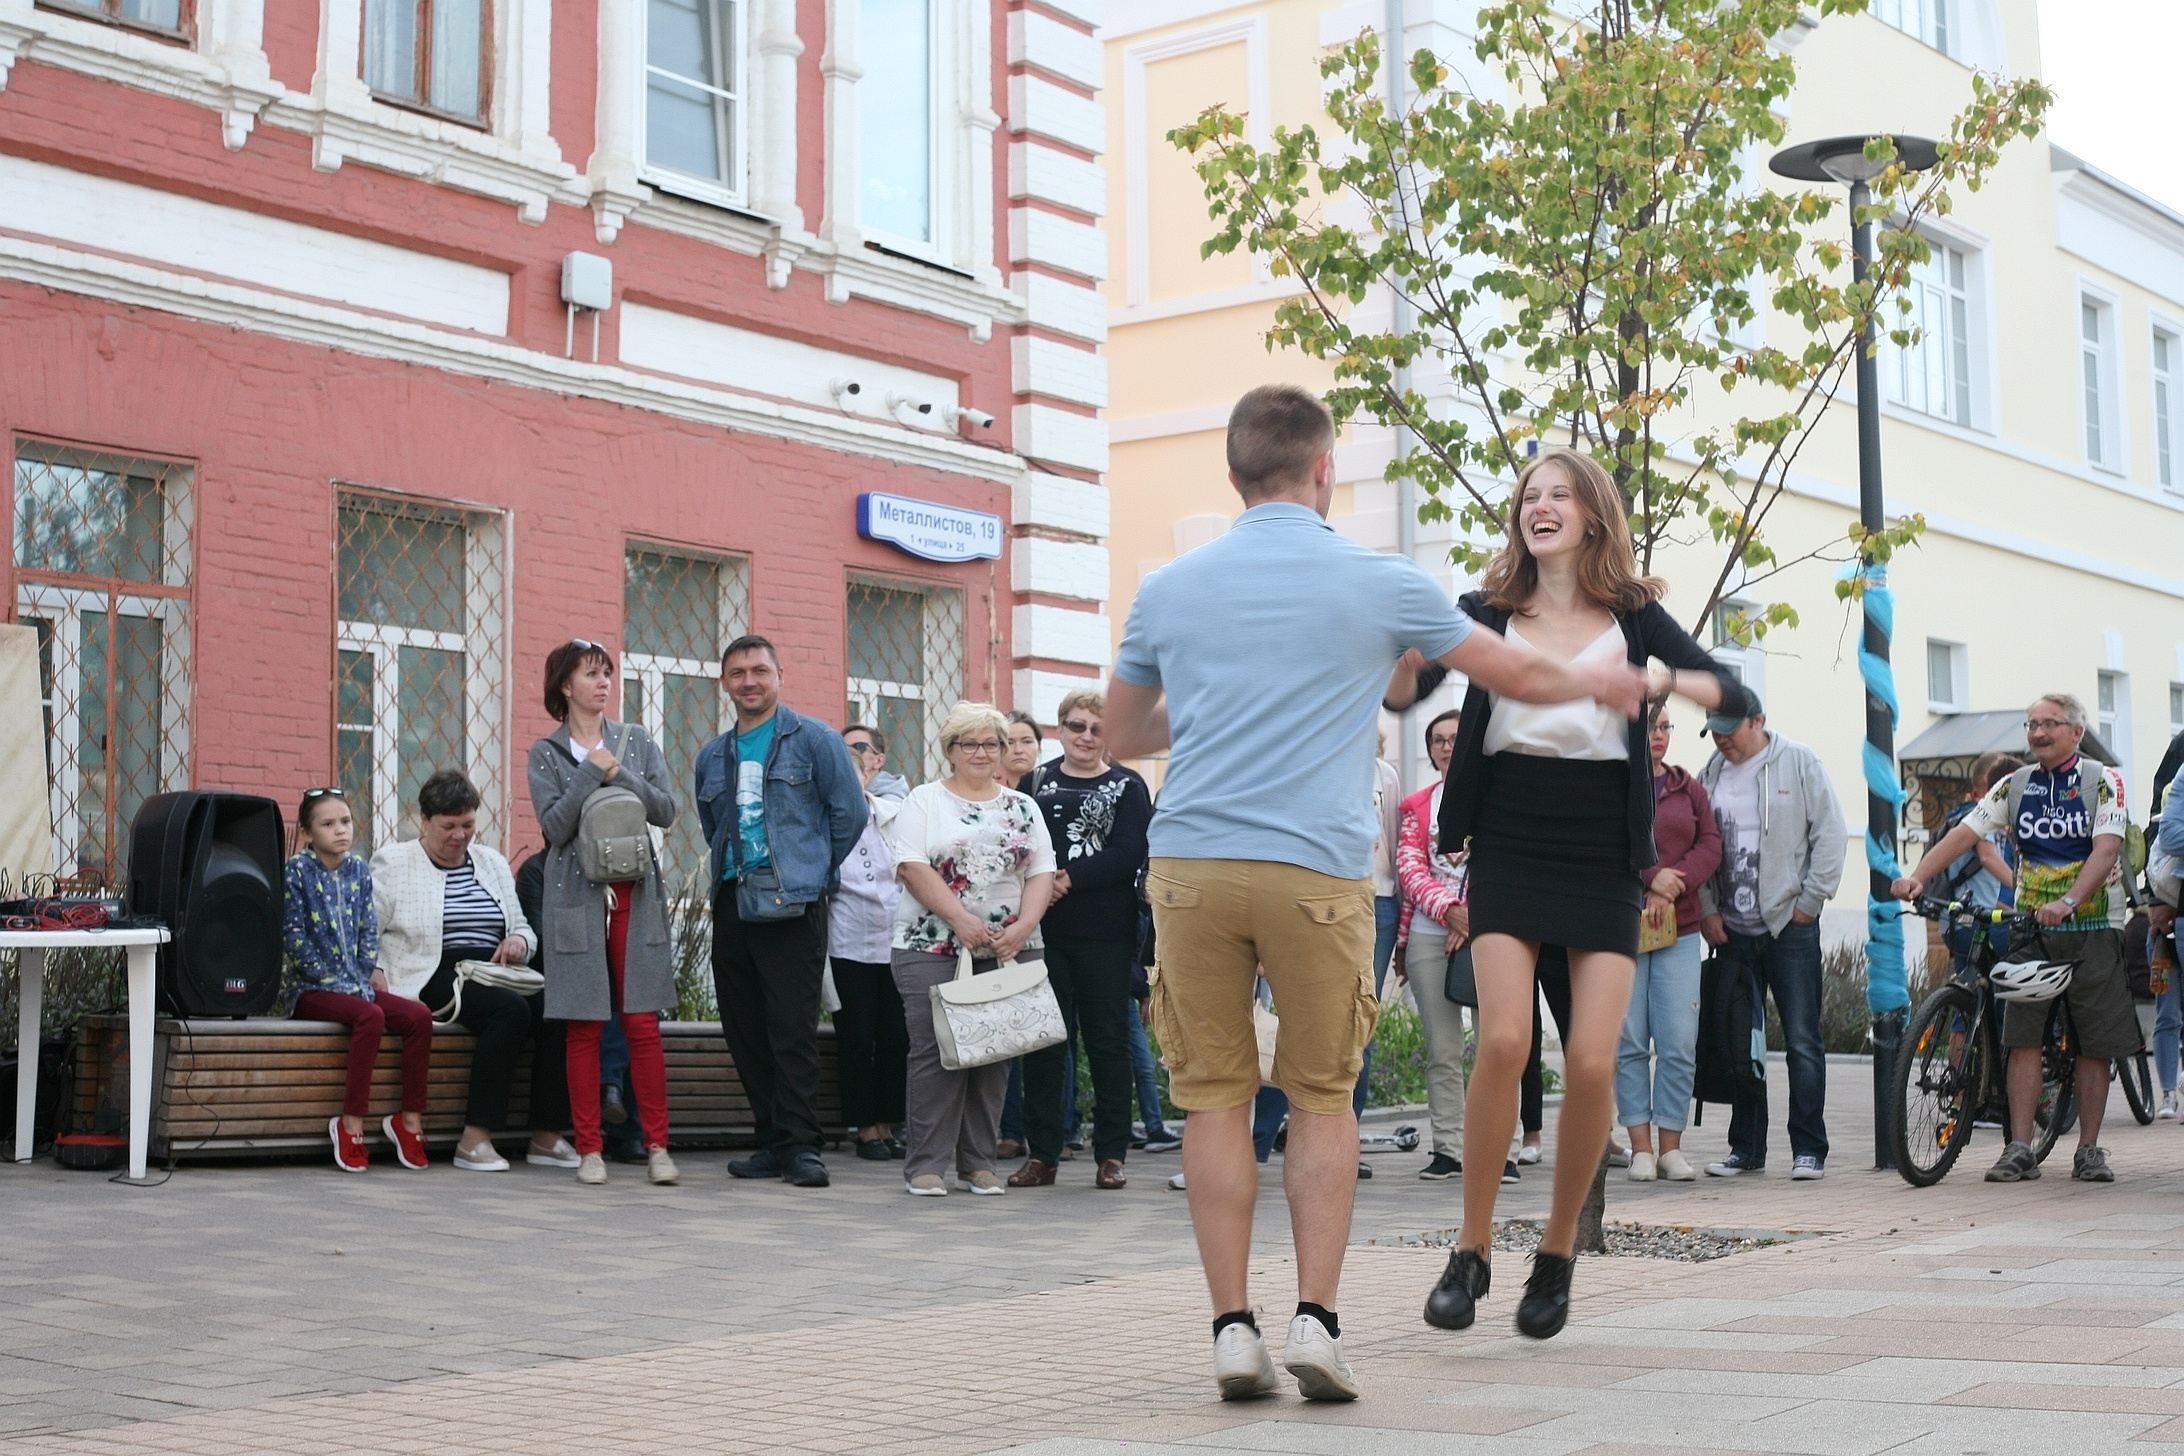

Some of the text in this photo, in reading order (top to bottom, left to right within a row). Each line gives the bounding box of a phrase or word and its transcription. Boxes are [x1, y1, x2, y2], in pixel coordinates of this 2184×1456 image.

[879, 501, 995, 540] Металлистов, 19
[923, 537, 948, 549] улица
